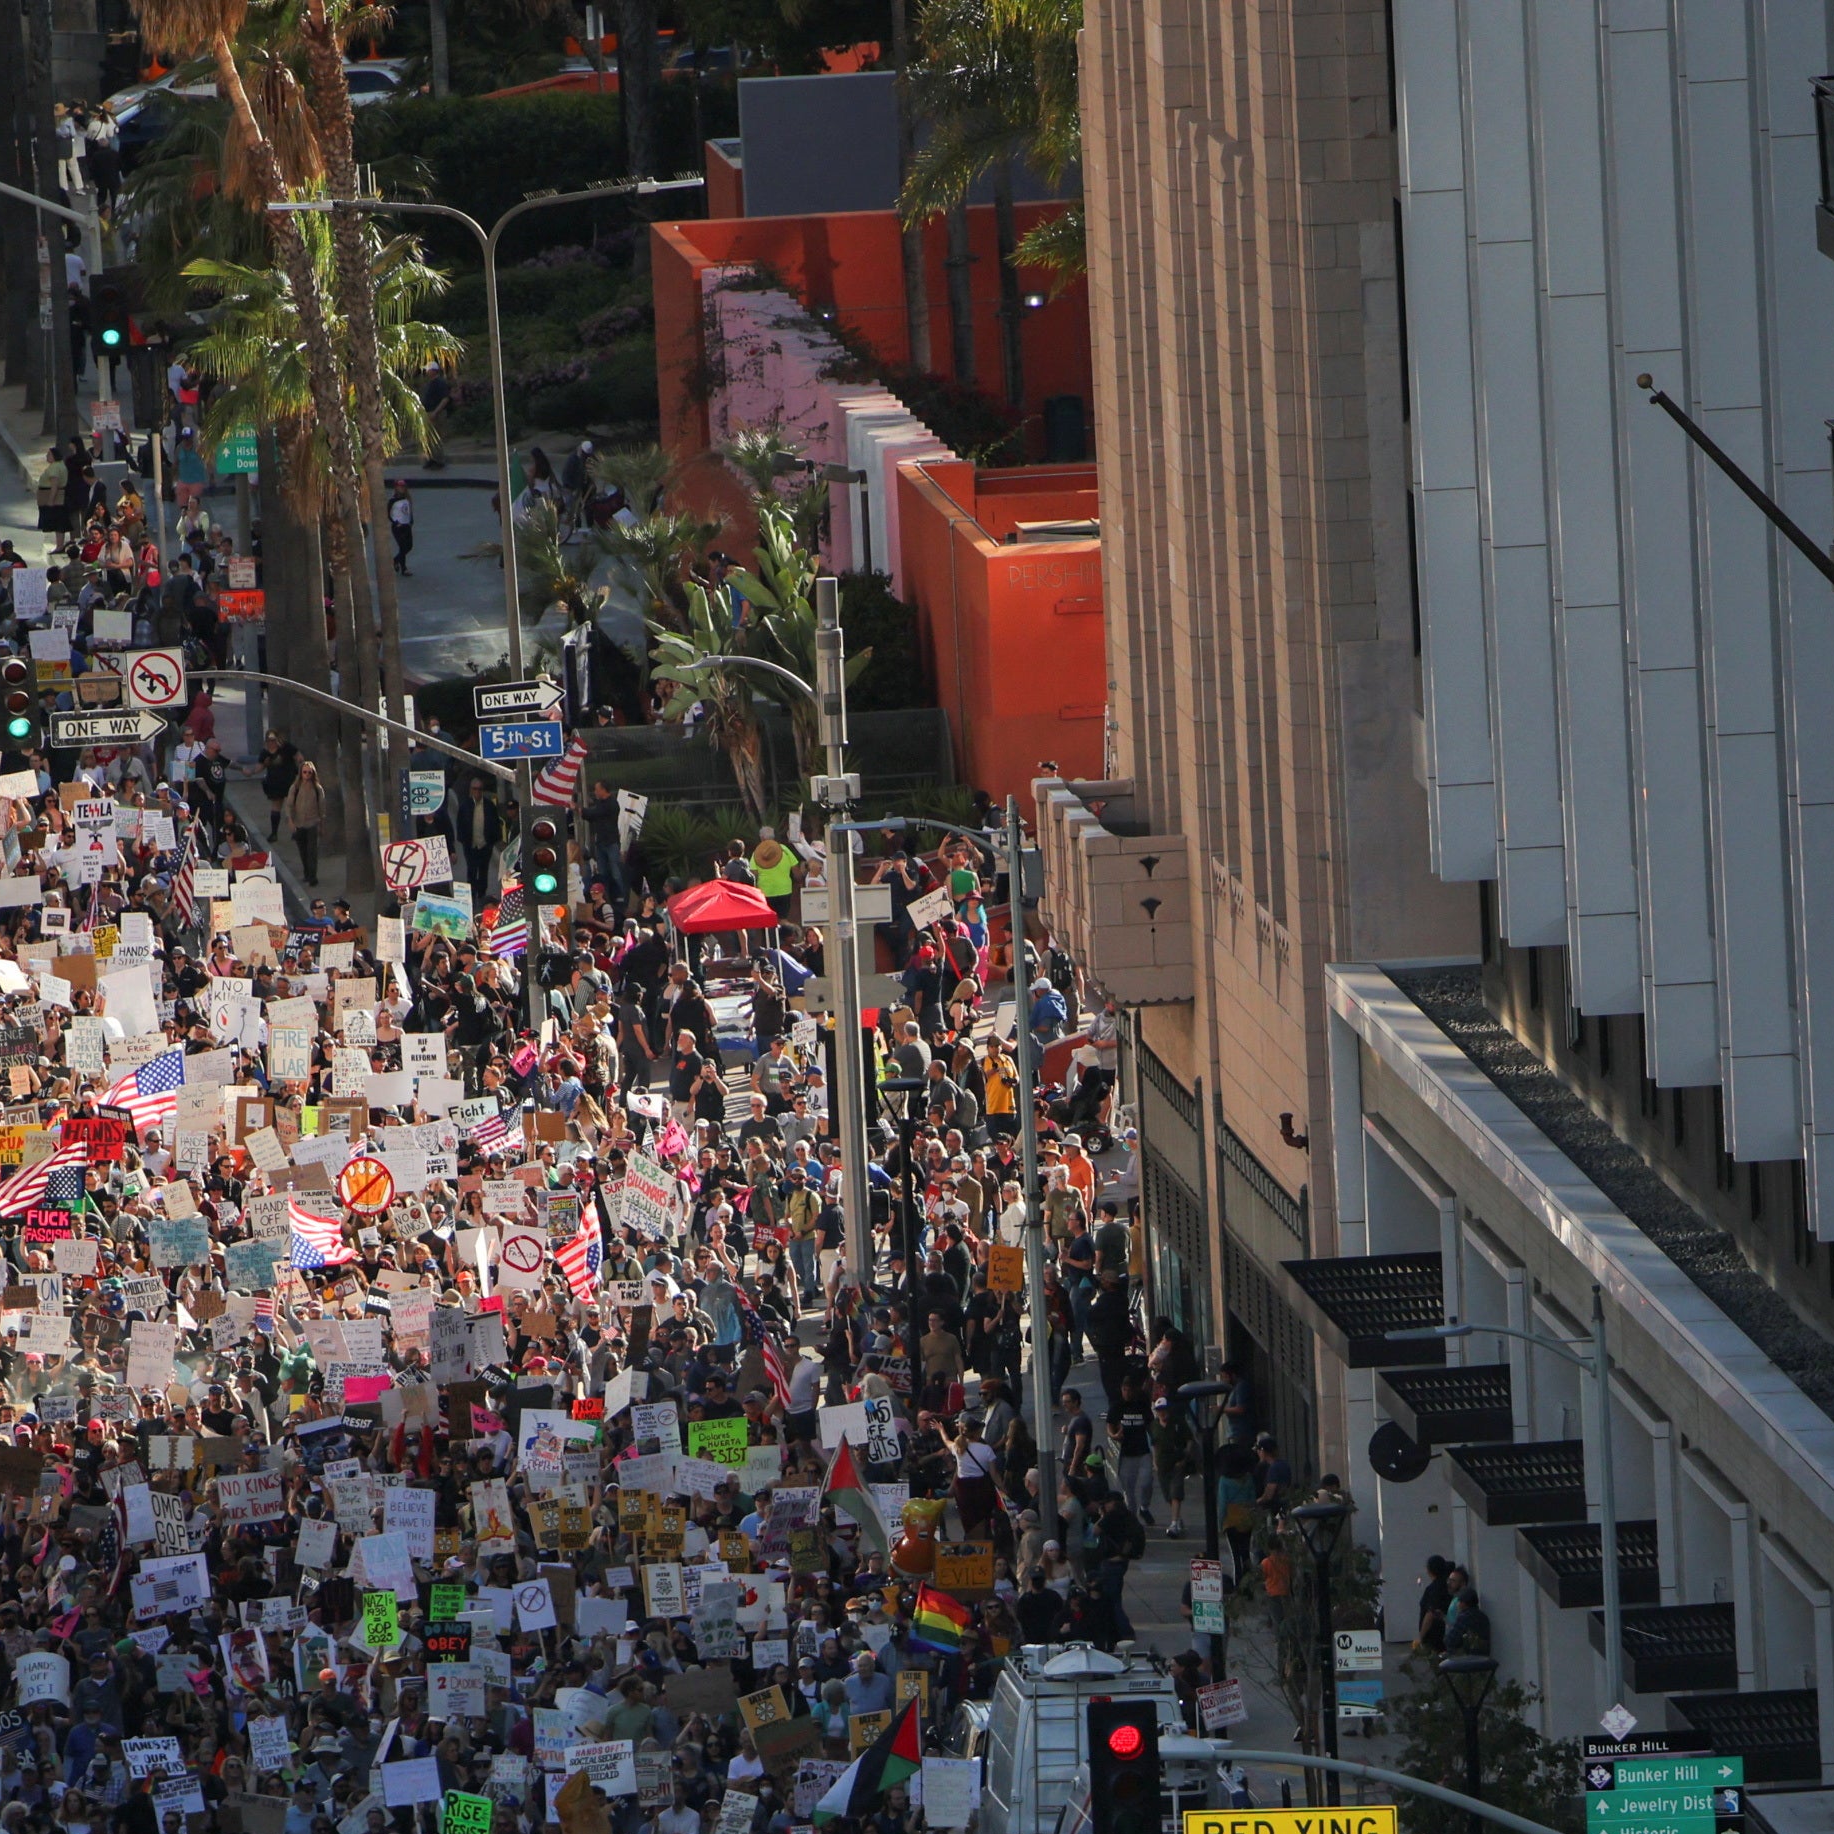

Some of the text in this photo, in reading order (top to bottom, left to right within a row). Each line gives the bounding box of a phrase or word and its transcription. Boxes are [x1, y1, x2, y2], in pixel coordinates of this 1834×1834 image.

[485, 691, 538, 707] ONE WAY
[65, 719, 141, 740] ONE WAY
[492, 730, 552, 752] 5th St
[272, 1030, 307, 1049] FIRE
[272, 1058, 306, 1077] LIAR
[65, 1121, 120, 1144] HANDS
[27, 1210, 70, 1227] FUCK
[26, 1228, 72, 1243] FASCISM
[221, 1473, 281, 1497] NO KINGS
[151, 1494, 182, 1521] OMG
[155, 1520, 186, 1545] GOP
[428, 1637, 467, 1651] OBEY
[1355, 1644, 1379, 1653] Metro
[1338, 1658, 1349, 1668] 94
[1201, 1697, 1214, 1708] NO
[1588, 1741, 1670, 1756] BUNKER HILL
[1617, 1766, 1700, 1784] Bunker Hill
[447, 1792, 482, 1822] RISE
[1620, 1795, 1714, 1815] Jewelry Dist
